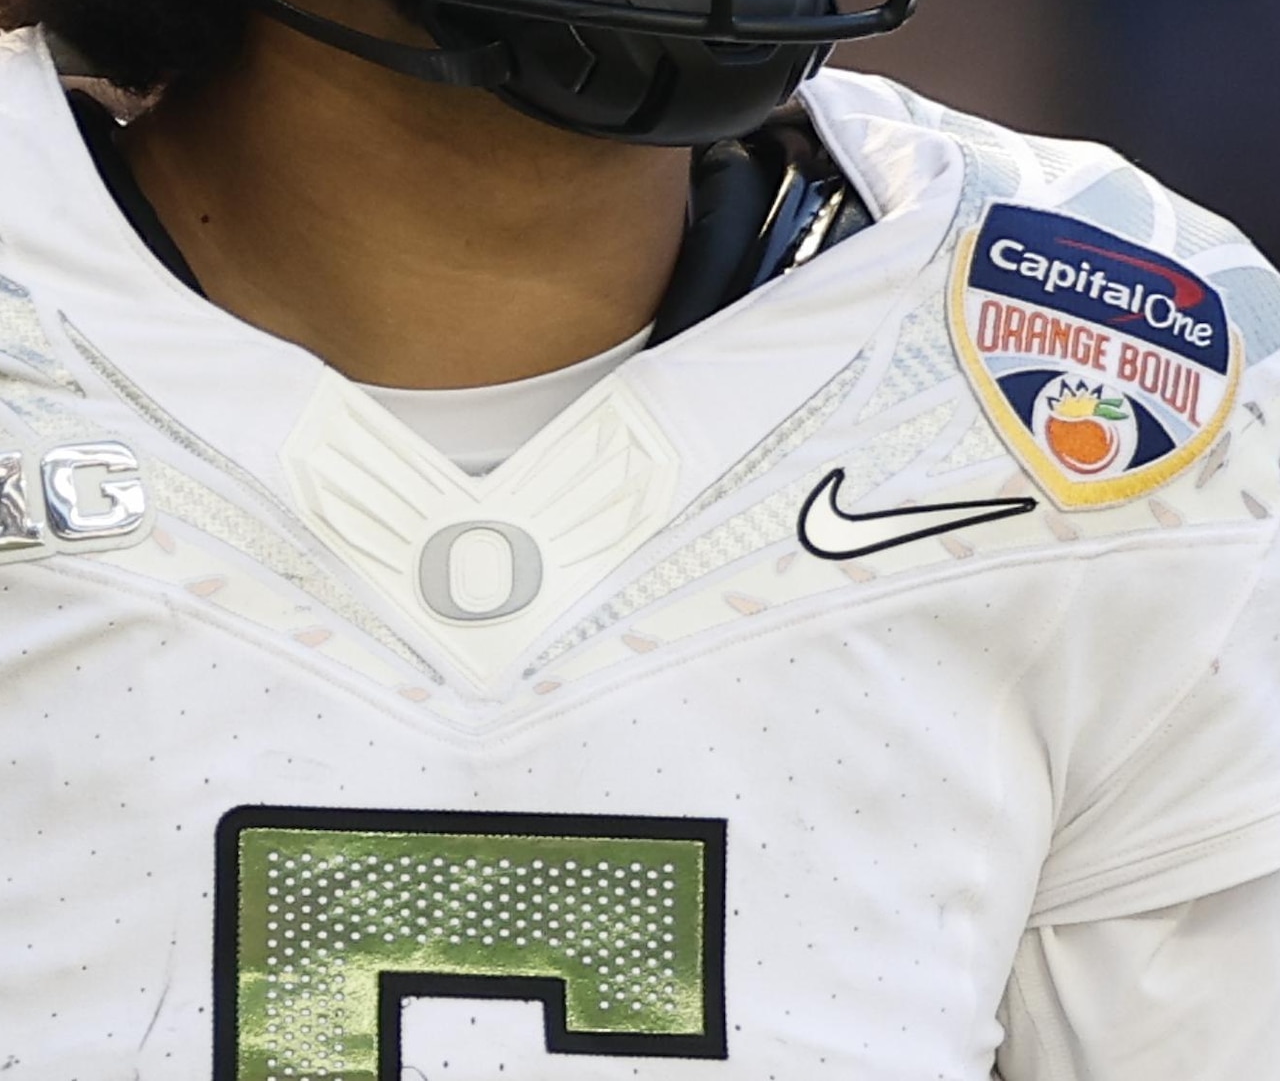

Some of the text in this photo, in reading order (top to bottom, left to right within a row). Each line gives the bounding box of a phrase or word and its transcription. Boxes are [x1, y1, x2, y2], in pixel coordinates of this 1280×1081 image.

[976, 299, 1202, 428] ORANGE BOWL
[418, 520, 543, 621] O
